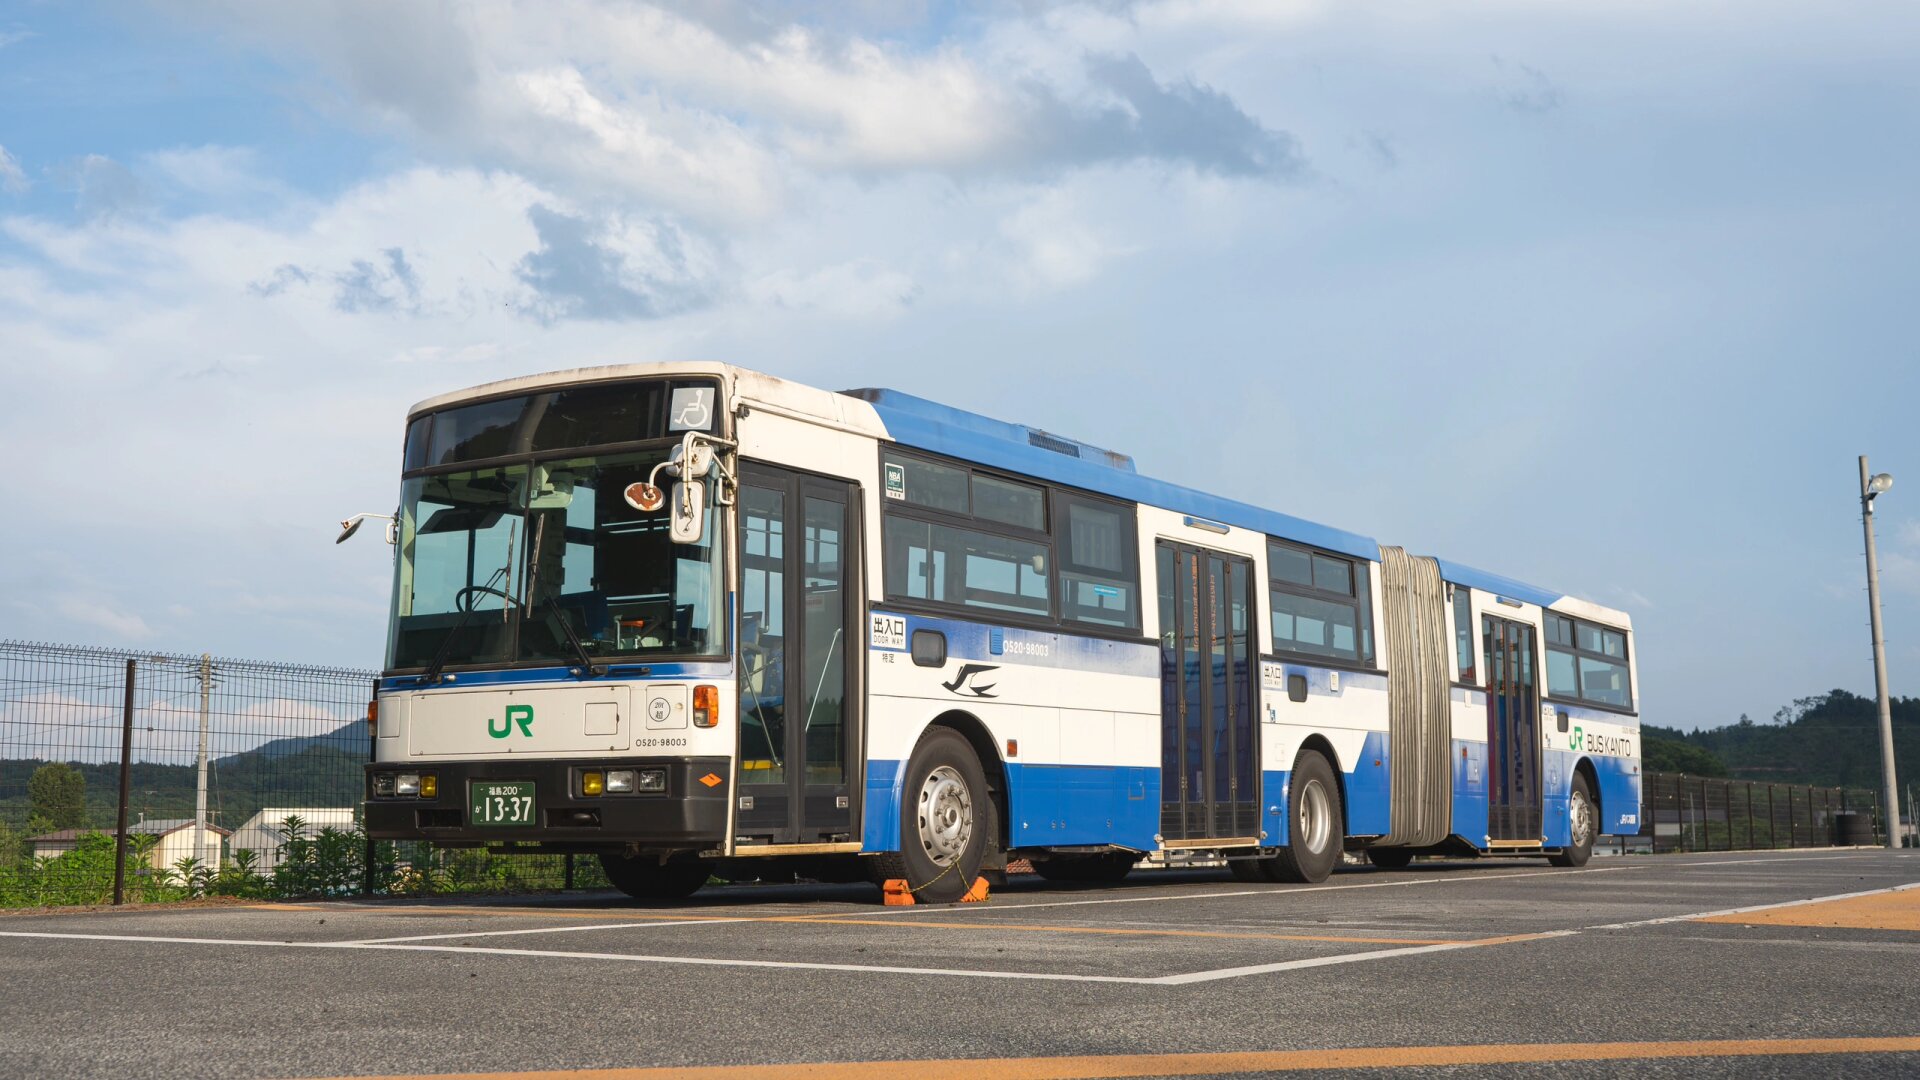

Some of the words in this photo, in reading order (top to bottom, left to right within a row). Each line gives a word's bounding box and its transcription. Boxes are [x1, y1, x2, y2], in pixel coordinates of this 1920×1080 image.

[874, 617, 904, 637] 出入口
[874, 634, 889, 644] DOOR
[892, 637, 904, 646] WAY
[882, 653, 895, 664] 特定
[488, 704, 534, 739] JR
[1569, 726, 1583, 751] JR
[1587, 733, 1604, 753] BUS
[1604, 736, 1631, 757] KANTO
